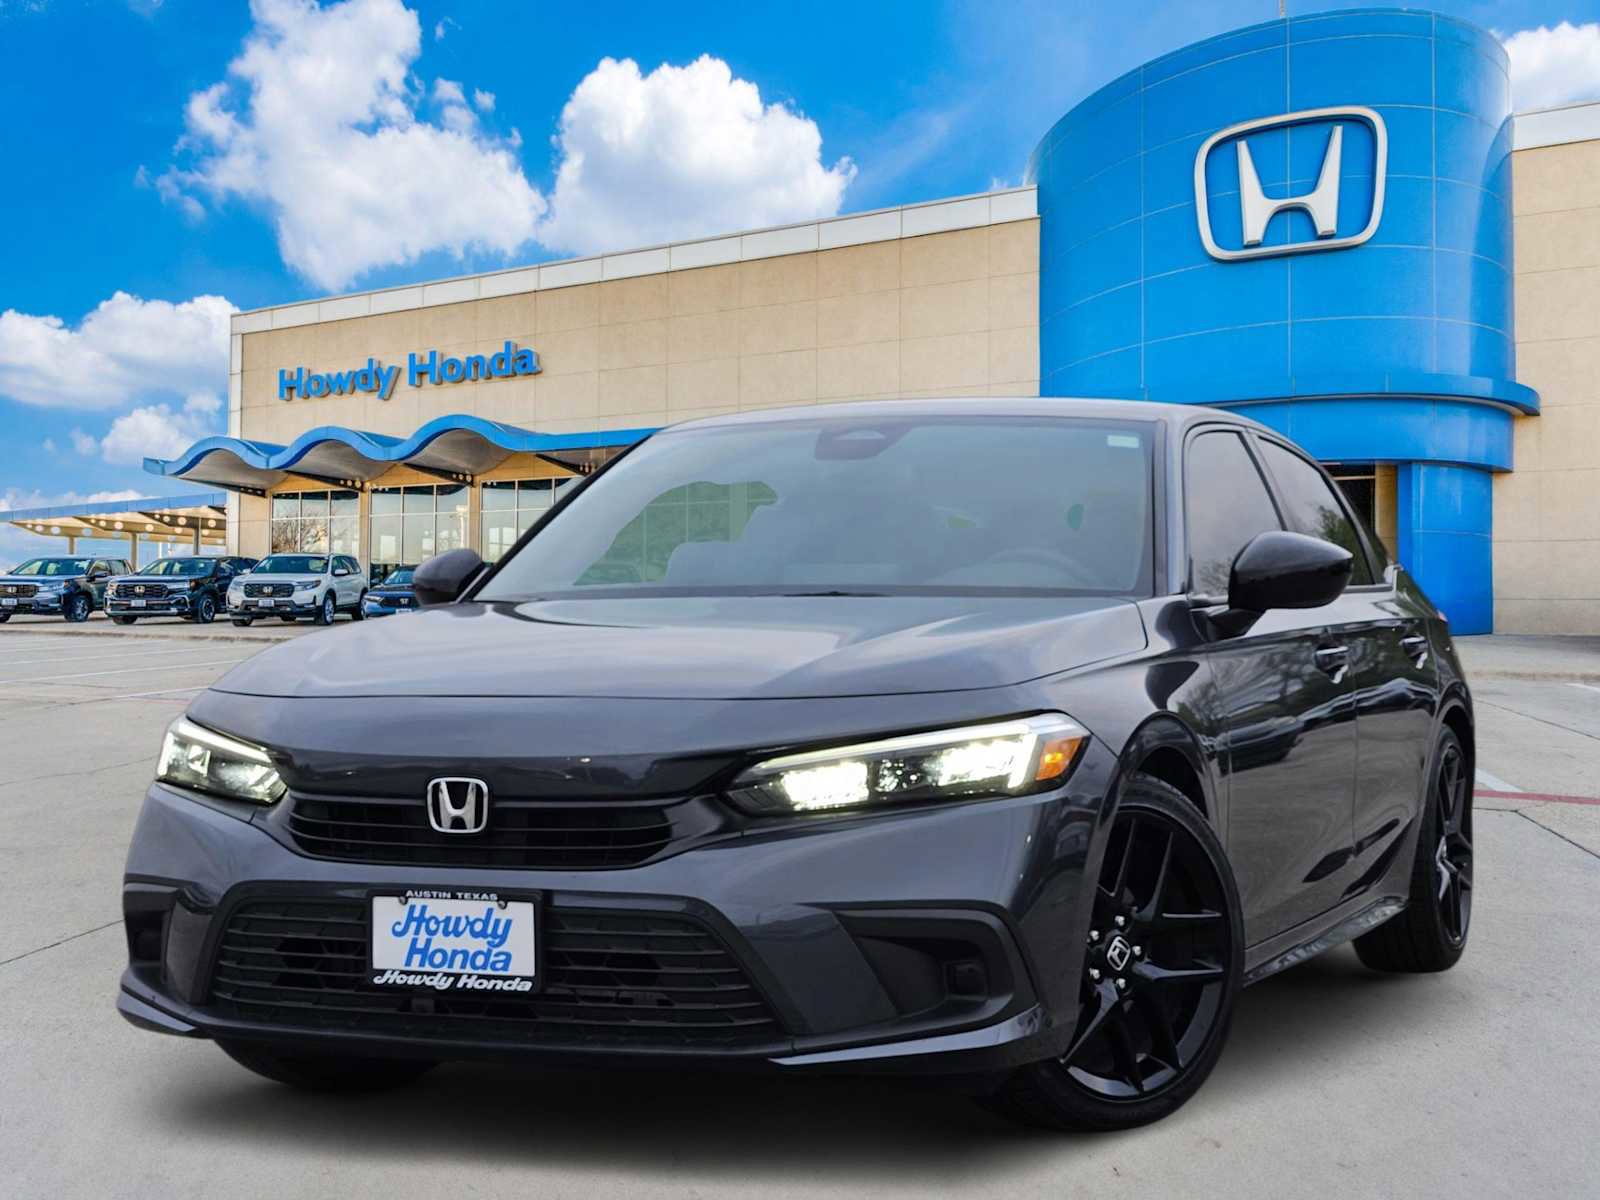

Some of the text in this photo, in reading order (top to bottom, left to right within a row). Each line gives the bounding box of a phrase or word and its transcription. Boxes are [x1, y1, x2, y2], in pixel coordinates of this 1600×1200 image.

[278, 340, 542, 401] Howdy Honda
[405, 890, 498, 901] AUSTIN TEXAS
[391, 904, 513, 948] Howdy
[404, 937, 512, 972] Honda
[373, 970, 533, 992] Howdy Honda
